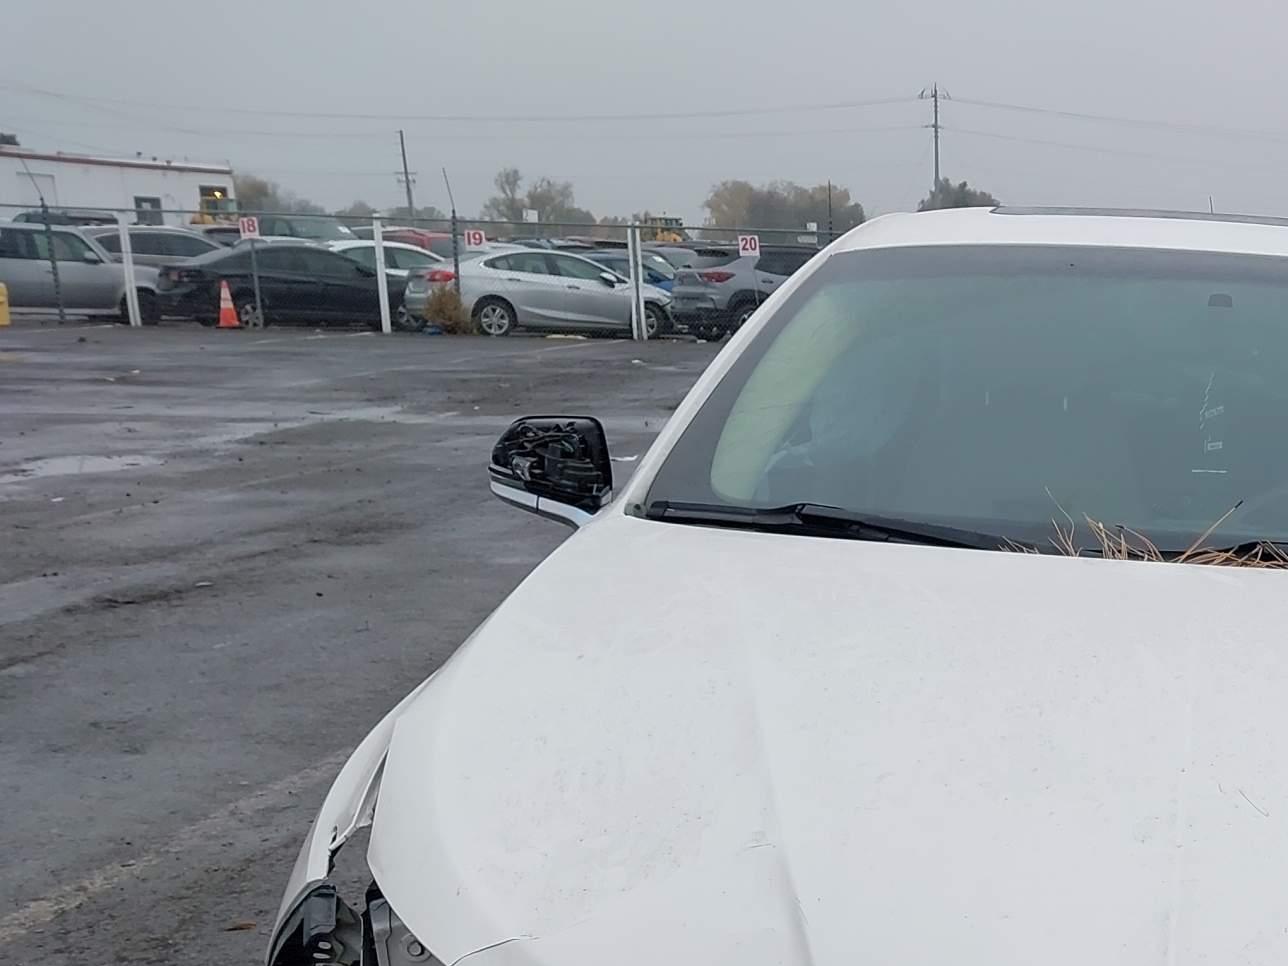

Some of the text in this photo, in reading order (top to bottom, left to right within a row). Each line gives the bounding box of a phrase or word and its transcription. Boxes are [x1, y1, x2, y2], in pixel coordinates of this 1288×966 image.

[241, 219, 256, 233] 18
[467, 231, 482, 245] 19
[740, 237, 757, 251] 20
